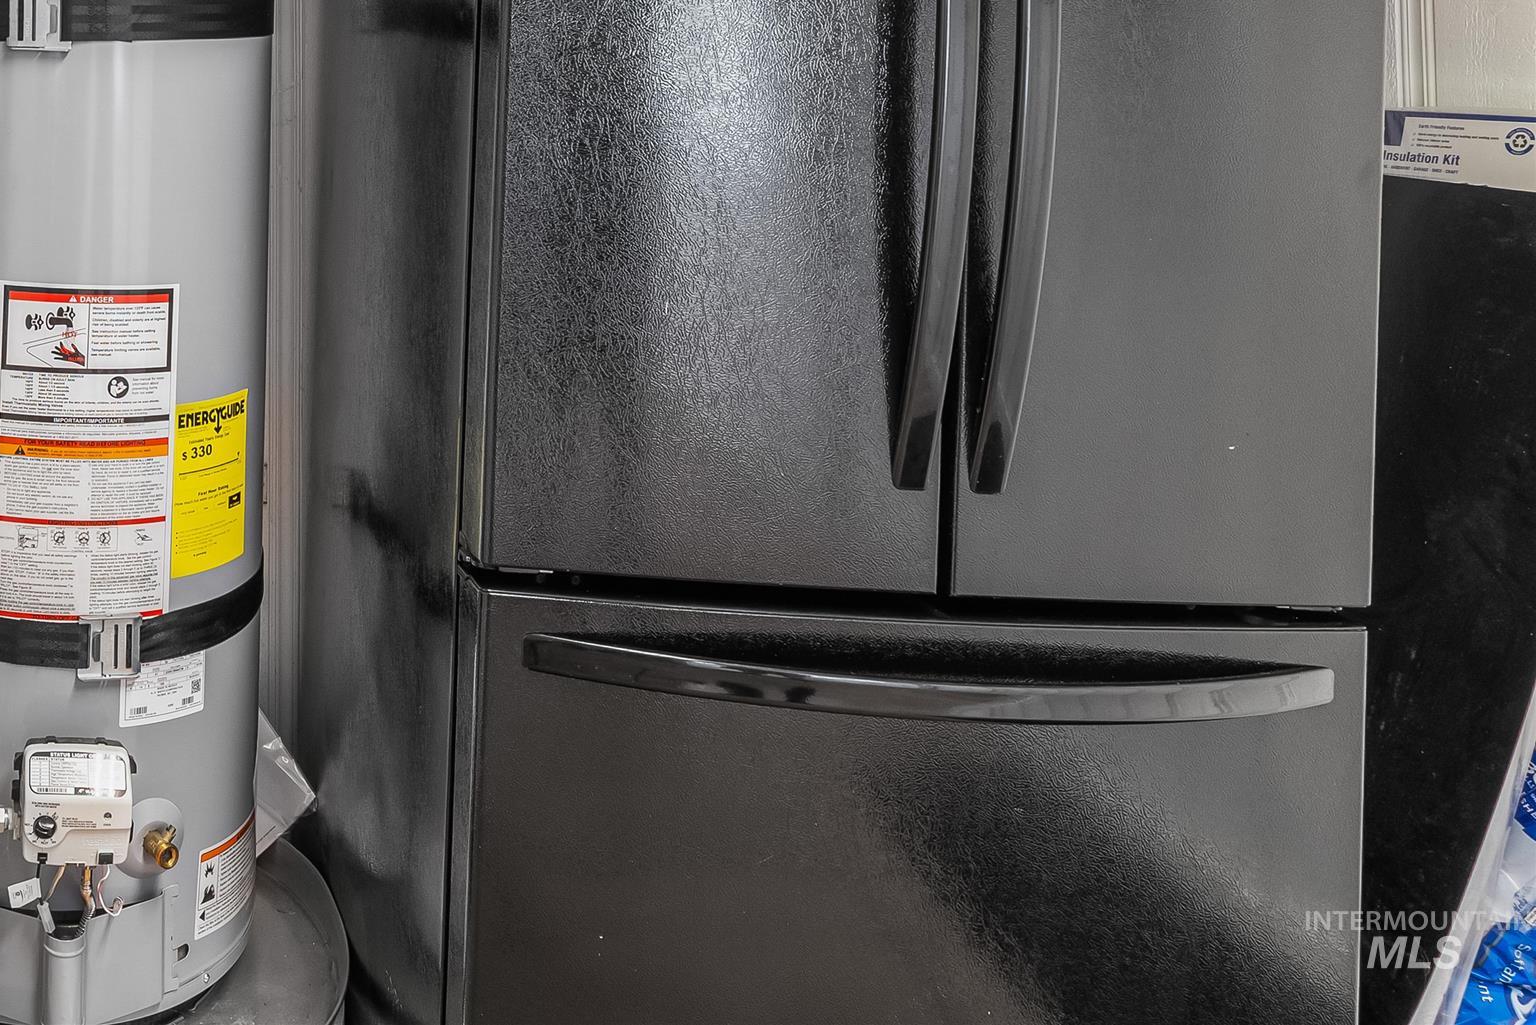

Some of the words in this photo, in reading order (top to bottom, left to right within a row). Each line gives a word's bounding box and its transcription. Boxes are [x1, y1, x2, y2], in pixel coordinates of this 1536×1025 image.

[1384, 150, 1439, 164] Insulation
[1442, 154, 1461, 166] Kit
[80, 296, 114, 304] DANGER
[178, 399, 245, 432] ENERGYGUIDE
[191, 444, 213, 459] 330
[1514, 943, 1532, 971] Soft
[1499, 966, 1517, 984] an
